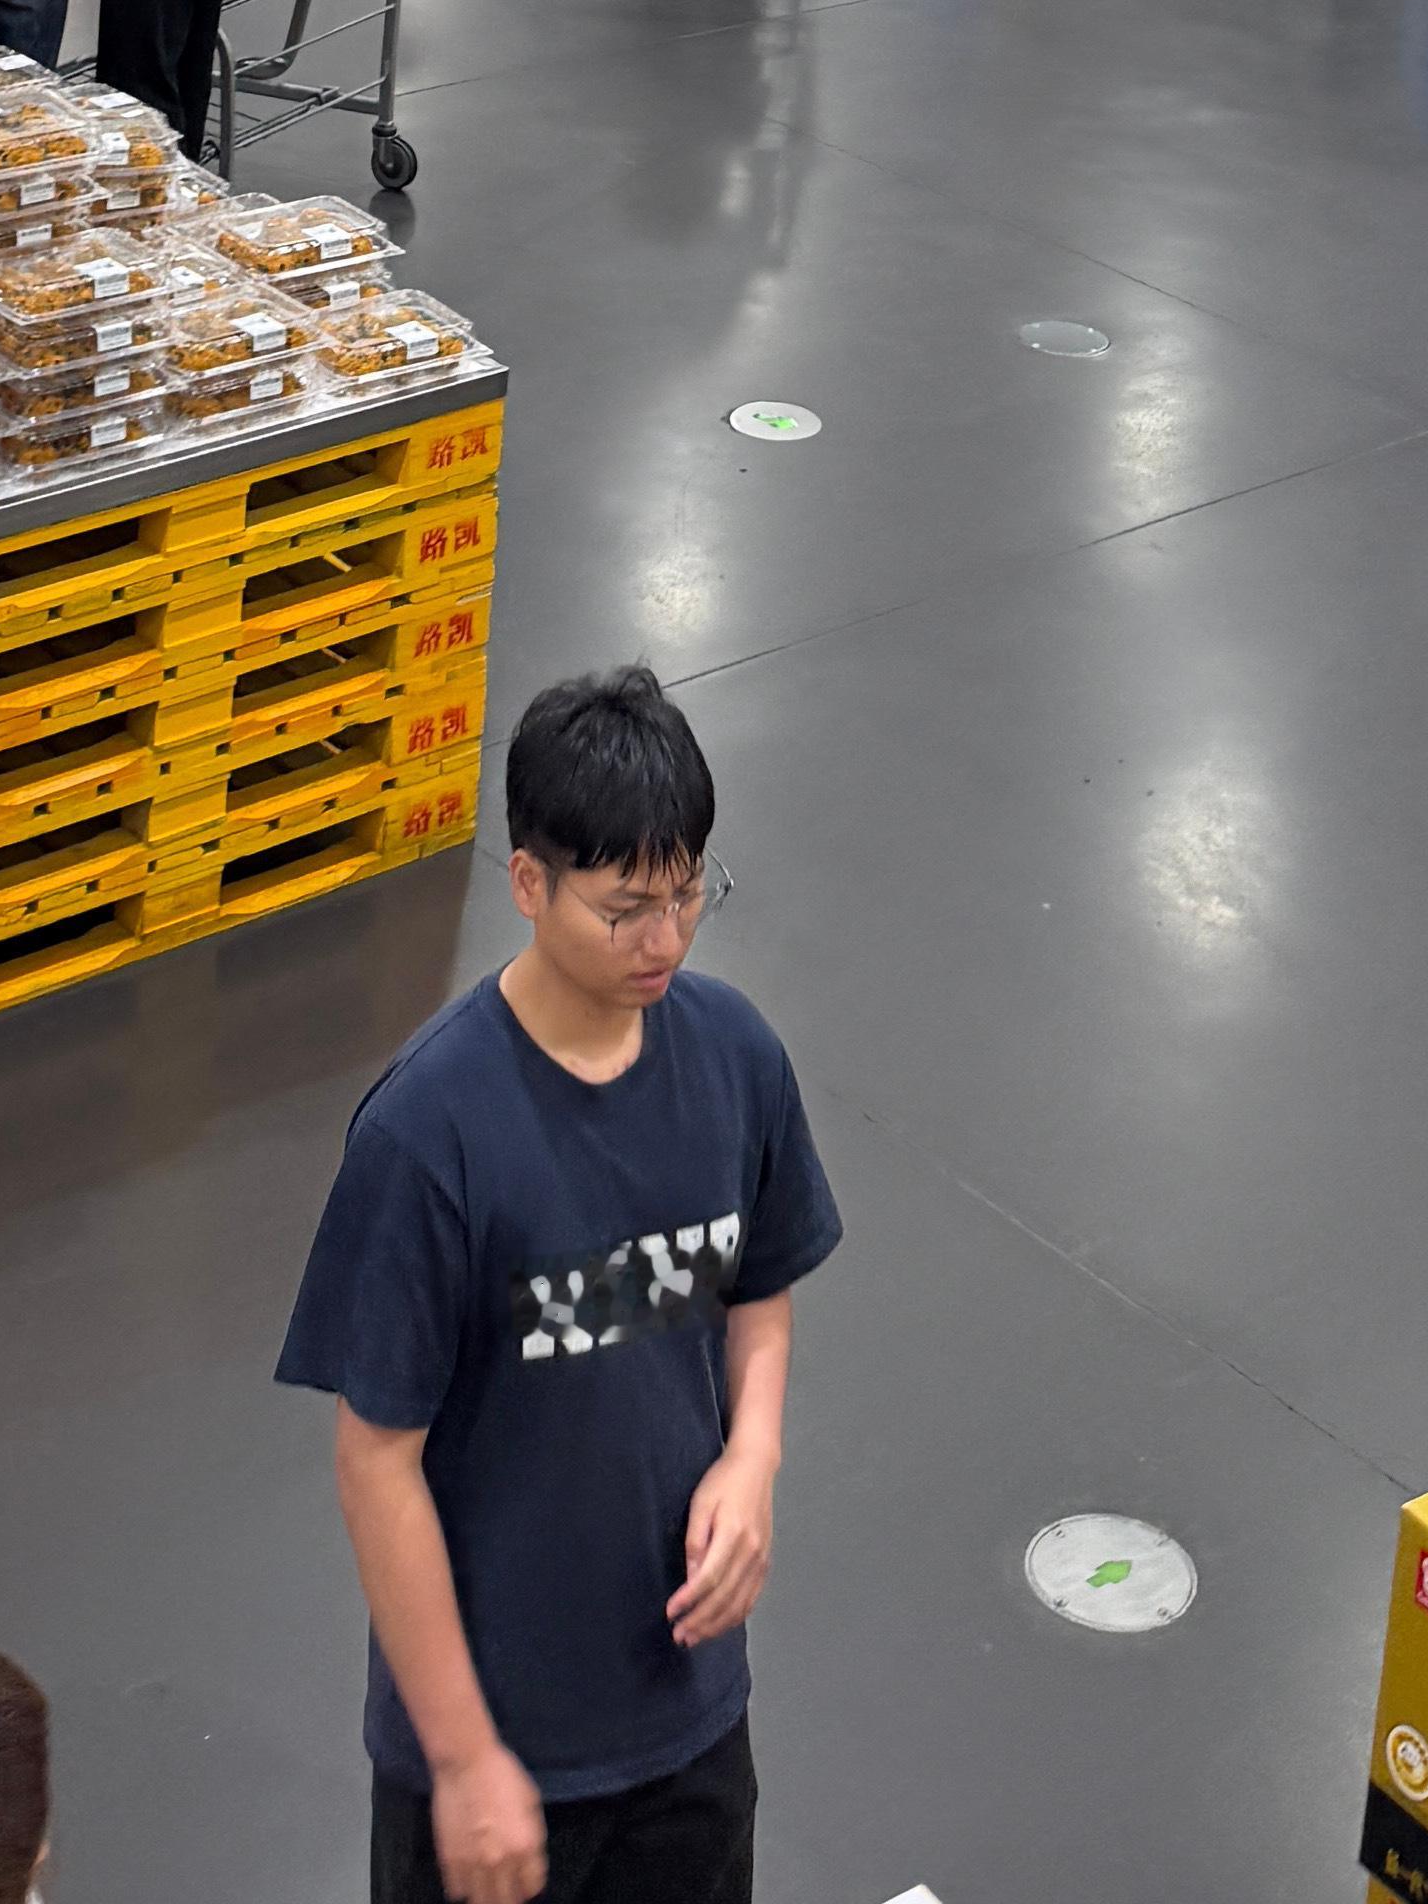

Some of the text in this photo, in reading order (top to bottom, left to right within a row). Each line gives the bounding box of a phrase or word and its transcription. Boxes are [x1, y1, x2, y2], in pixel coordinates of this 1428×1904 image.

[427, 426, 489, 470] 路凯
[419, 516, 482, 564] 路凯
[414, 612, 475, 659] 路凯
[407, 704, 469, 755] 路凯
